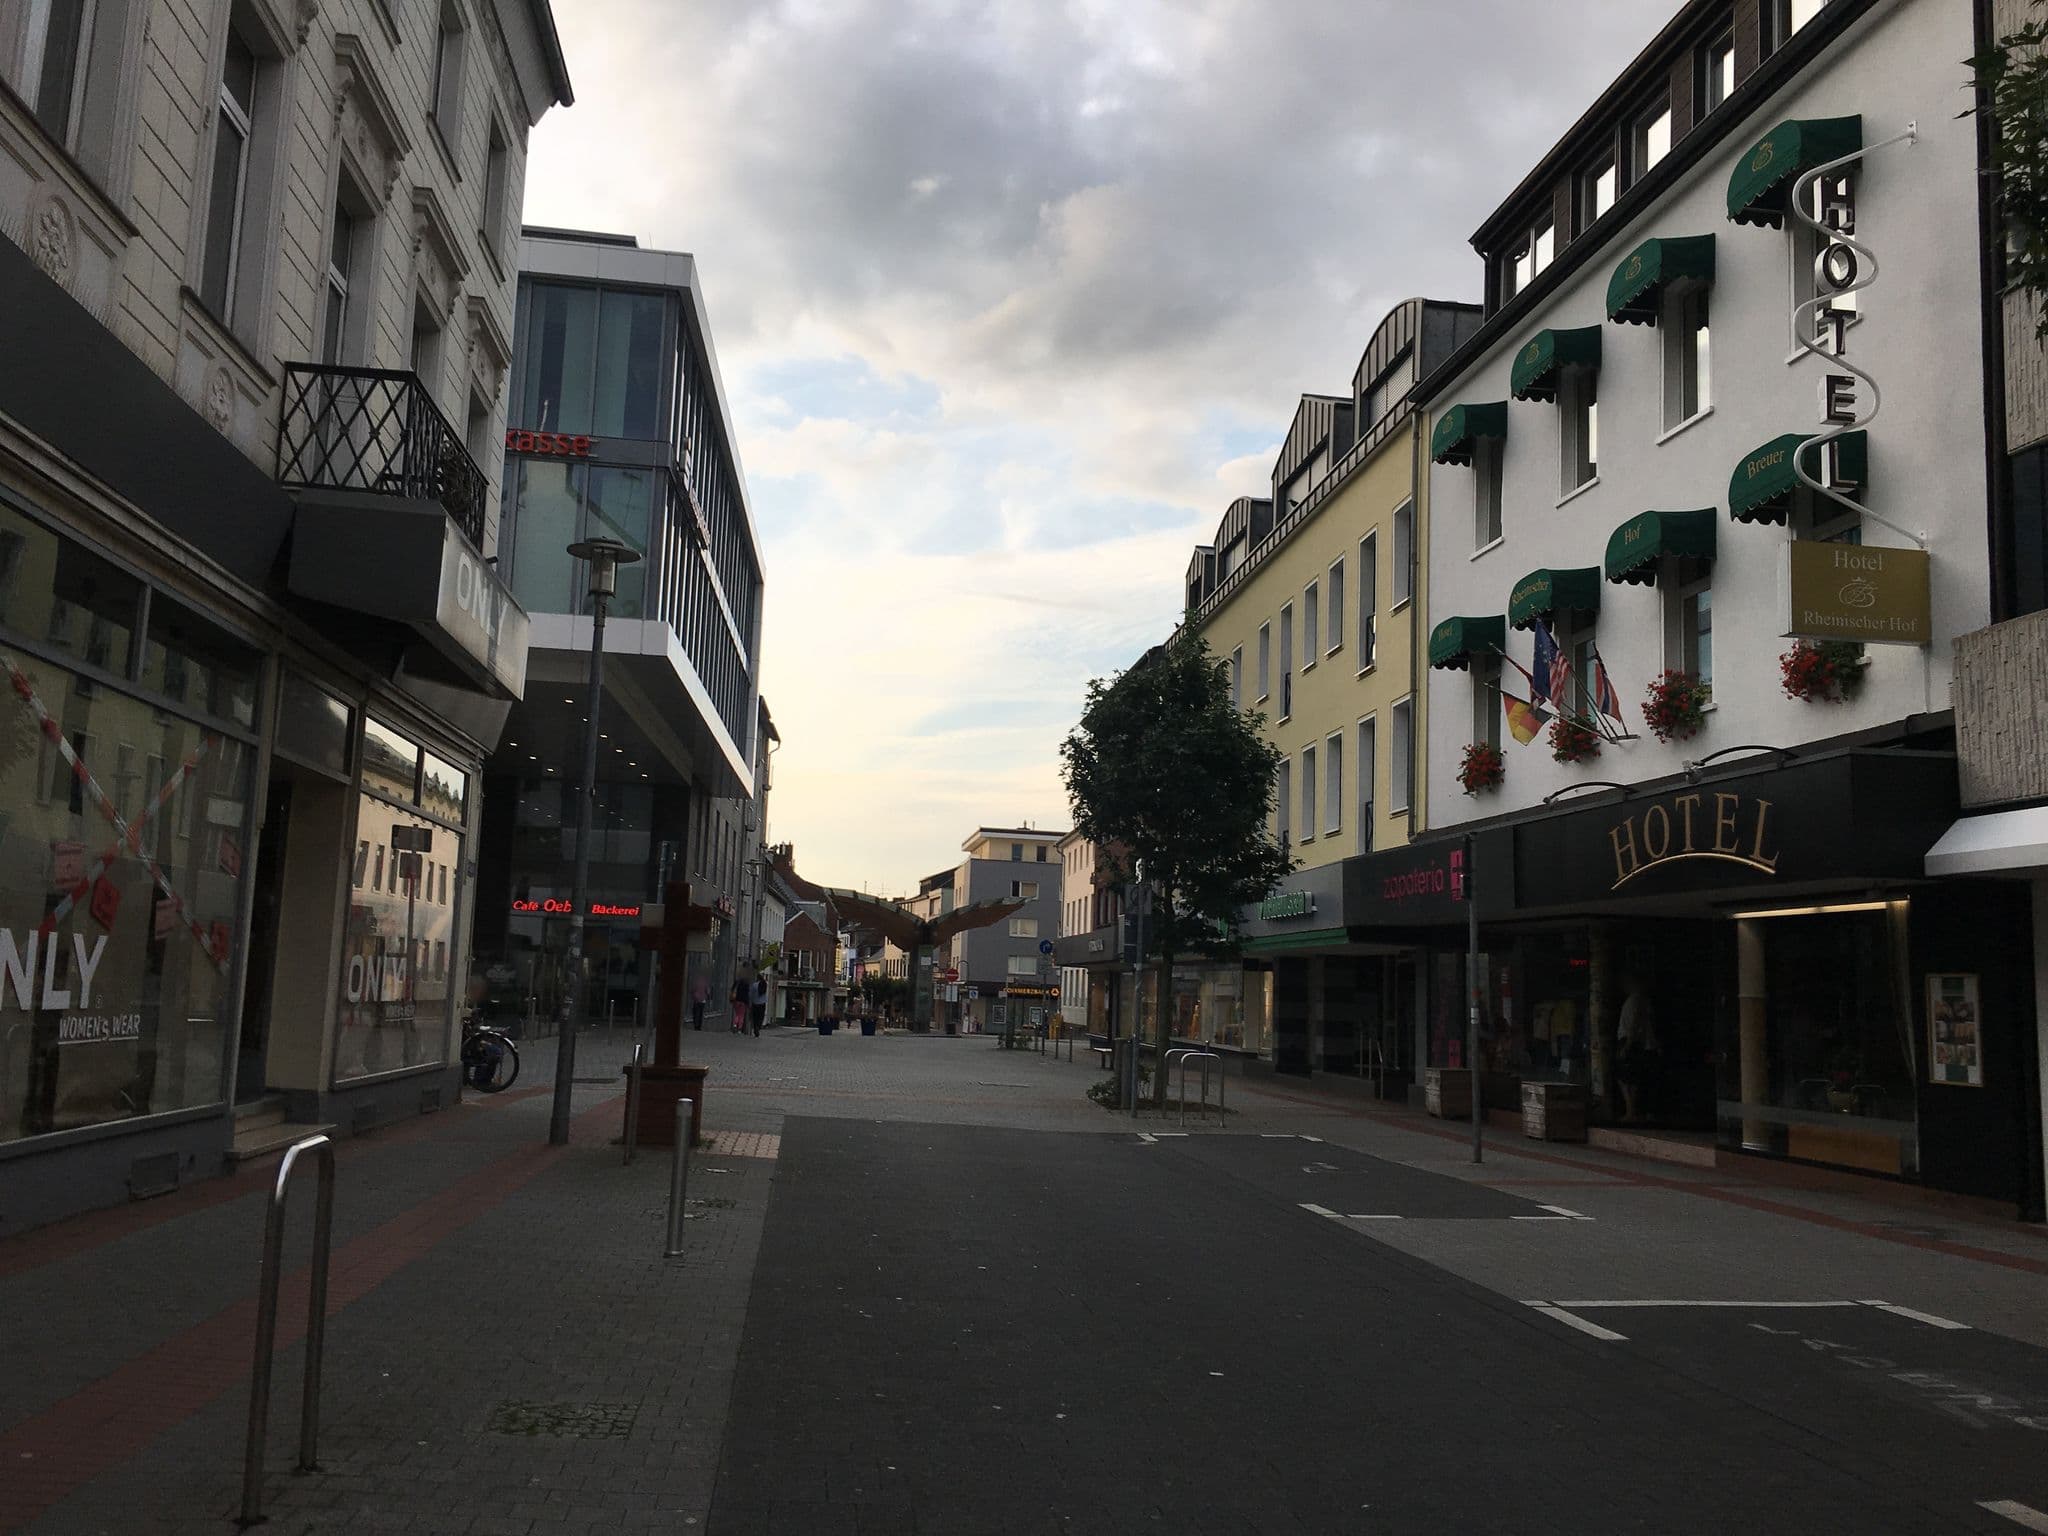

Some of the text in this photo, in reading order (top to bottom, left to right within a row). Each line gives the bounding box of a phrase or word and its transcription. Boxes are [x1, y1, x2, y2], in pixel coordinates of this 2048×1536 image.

[1815, 175, 1858, 490] HOTEL
[1747, 449, 1785, 479] Breuer
[1624, 522, 1642, 545] Hof
[1833, 550, 1883, 571] Hotel
[457, 552, 508, 646] ONLY
[1804, 610, 1918, 633] Rheinischer Hof
[1609, 792, 1781, 882] HOTEL
[591, 903, 640, 916] Bäckerei
[112, 1013, 140, 1035] WEAR
